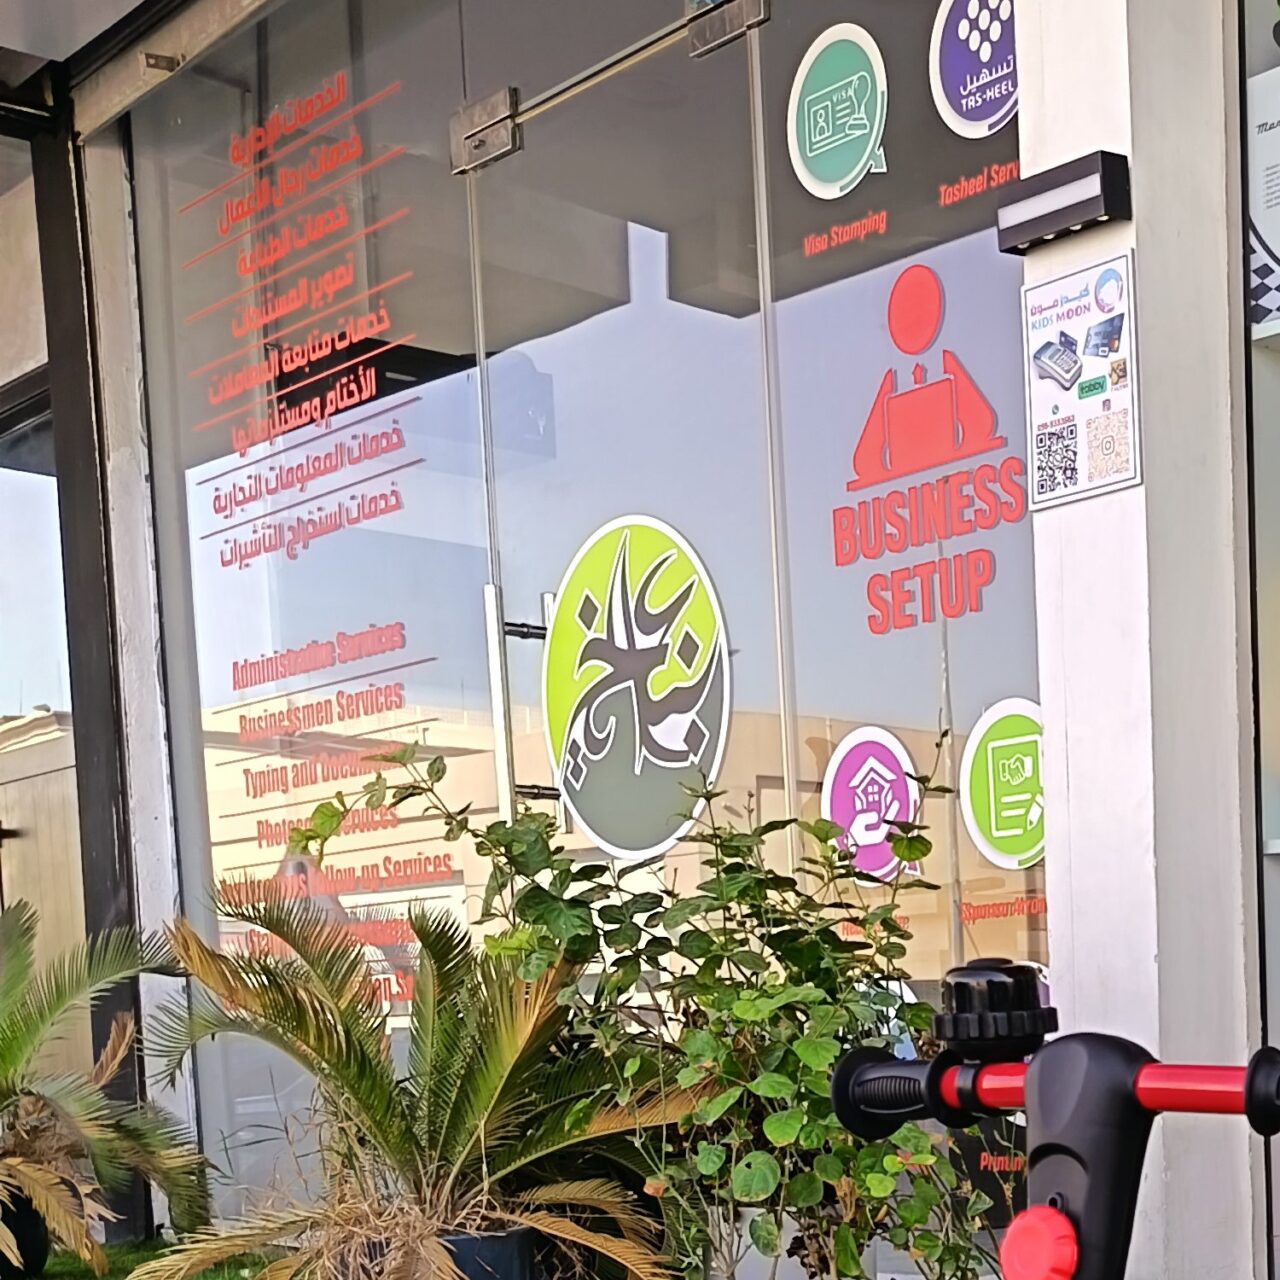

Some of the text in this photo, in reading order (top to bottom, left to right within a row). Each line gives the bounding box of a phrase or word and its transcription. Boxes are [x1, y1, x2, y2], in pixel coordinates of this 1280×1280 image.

[960, 54, 1014, 96] تسهيل
[961, 80, 1015, 112] TAS-HEEL
[307, 124, 362, 181] خدمات
[938, 160, 1020, 208] Tasheel Serv
[294, 195, 348, 248] خدمات
[804, 209, 887, 257] Visa Stamping
[334, 299, 391, 351] خدمات
[1031, 302, 1091, 331] KIDS MOON
[281, 328, 332, 374] متابعة
[324, 364, 377, 430] الأختام
[213, 418, 406, 520] خدمات المعلومات التجارية
[346, 481, 405, 526] خدمات
[832, 455, 1029, 567] BUSINESS
[220, 522, 285, 571] التأشيرات
[866, 547, 996, 636] SETUP
[336, 621, 407, 664] Services
[238, 682, 407, 743] Businessmen Services
[243, 764, 289, 799] Typing
[291, 757, 319, 789] and
[383, 852, 455, 888] Services
